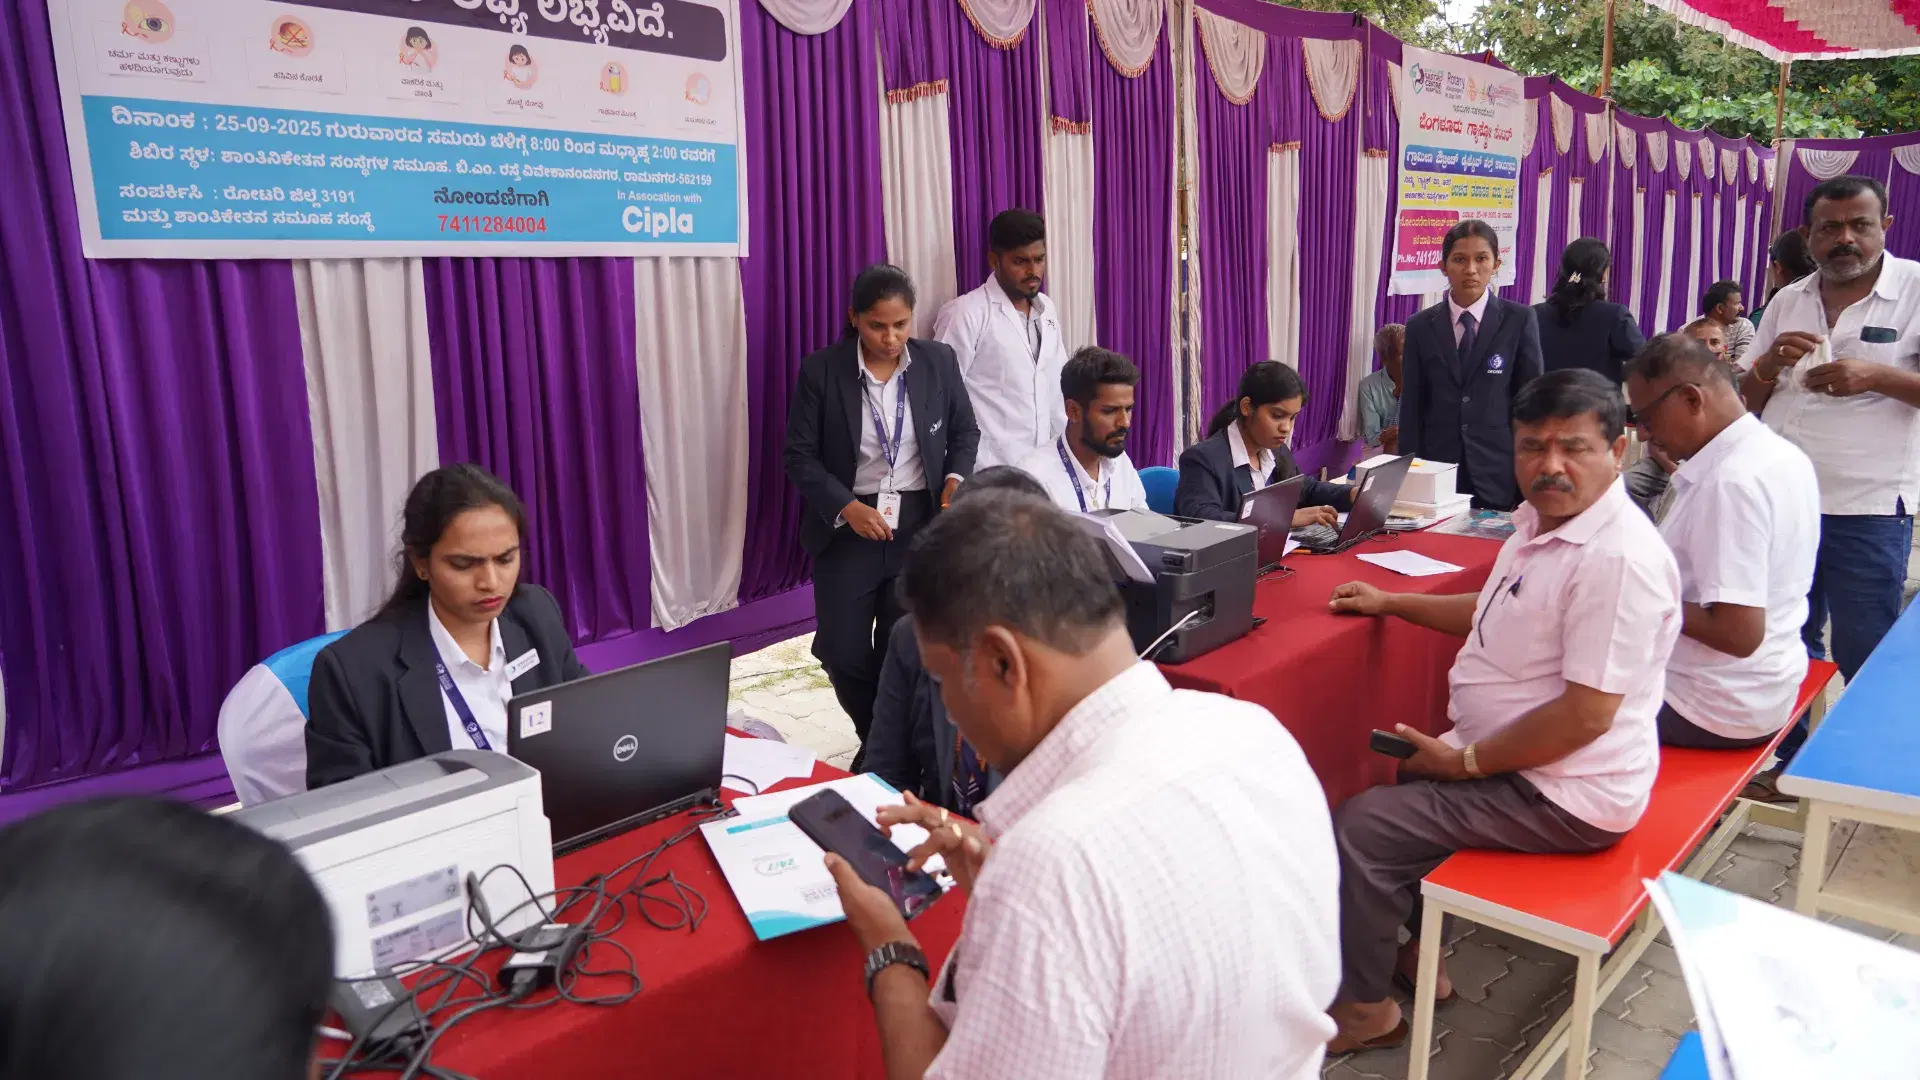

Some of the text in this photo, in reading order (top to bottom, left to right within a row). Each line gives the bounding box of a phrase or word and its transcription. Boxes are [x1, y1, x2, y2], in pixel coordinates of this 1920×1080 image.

[108, 50, 135, 59] ಚರ್ಮ
[138, 53, 161, 64] ಮತ್ತು
[111, 105, 195, 128] ದಿನಾಂಕ
[215, 114, 321, 137] 25-09-2025
[326, 122, 423, 143] ಗುರುವಾರದ
[427, 128, 486, 147] ಸಮಯ
[530, 136, 560, 151] 8:00
[564, 138, 596, 154] ರಿಂದ
[652, 145, 678, 160] 2:00
[680, 148, 716, 163] ರವರೆಗೆ
[129, 141, 175, 160] ಶಿಬಿರ
[221, 150, 326, 168] ಶಾಂತಿನಿಕೇತನ
[499, 163, 522, 182] ರಸ್ತೆ
[119, 183, 204, 199] ಸಂಪರ್ಕಿಸಿ
[223, 185, 285, 201] ರೋಟರಿ
[321, 189, 355, 203] 3191
[433, 186, 550, 207] ನೋಂದಣಿಗಾಗಿ
[617, 189, 703, 203] In Assocation with
[122, 208, 375, 233] ಮತ್ತು ಶಾಂತಿಕೇತನ ಸಮೂಹ ಸಂಸ್ಥೆ
[437, 215, 547, 233] 7411284004
[622, 205, 694, 238] Cipla
